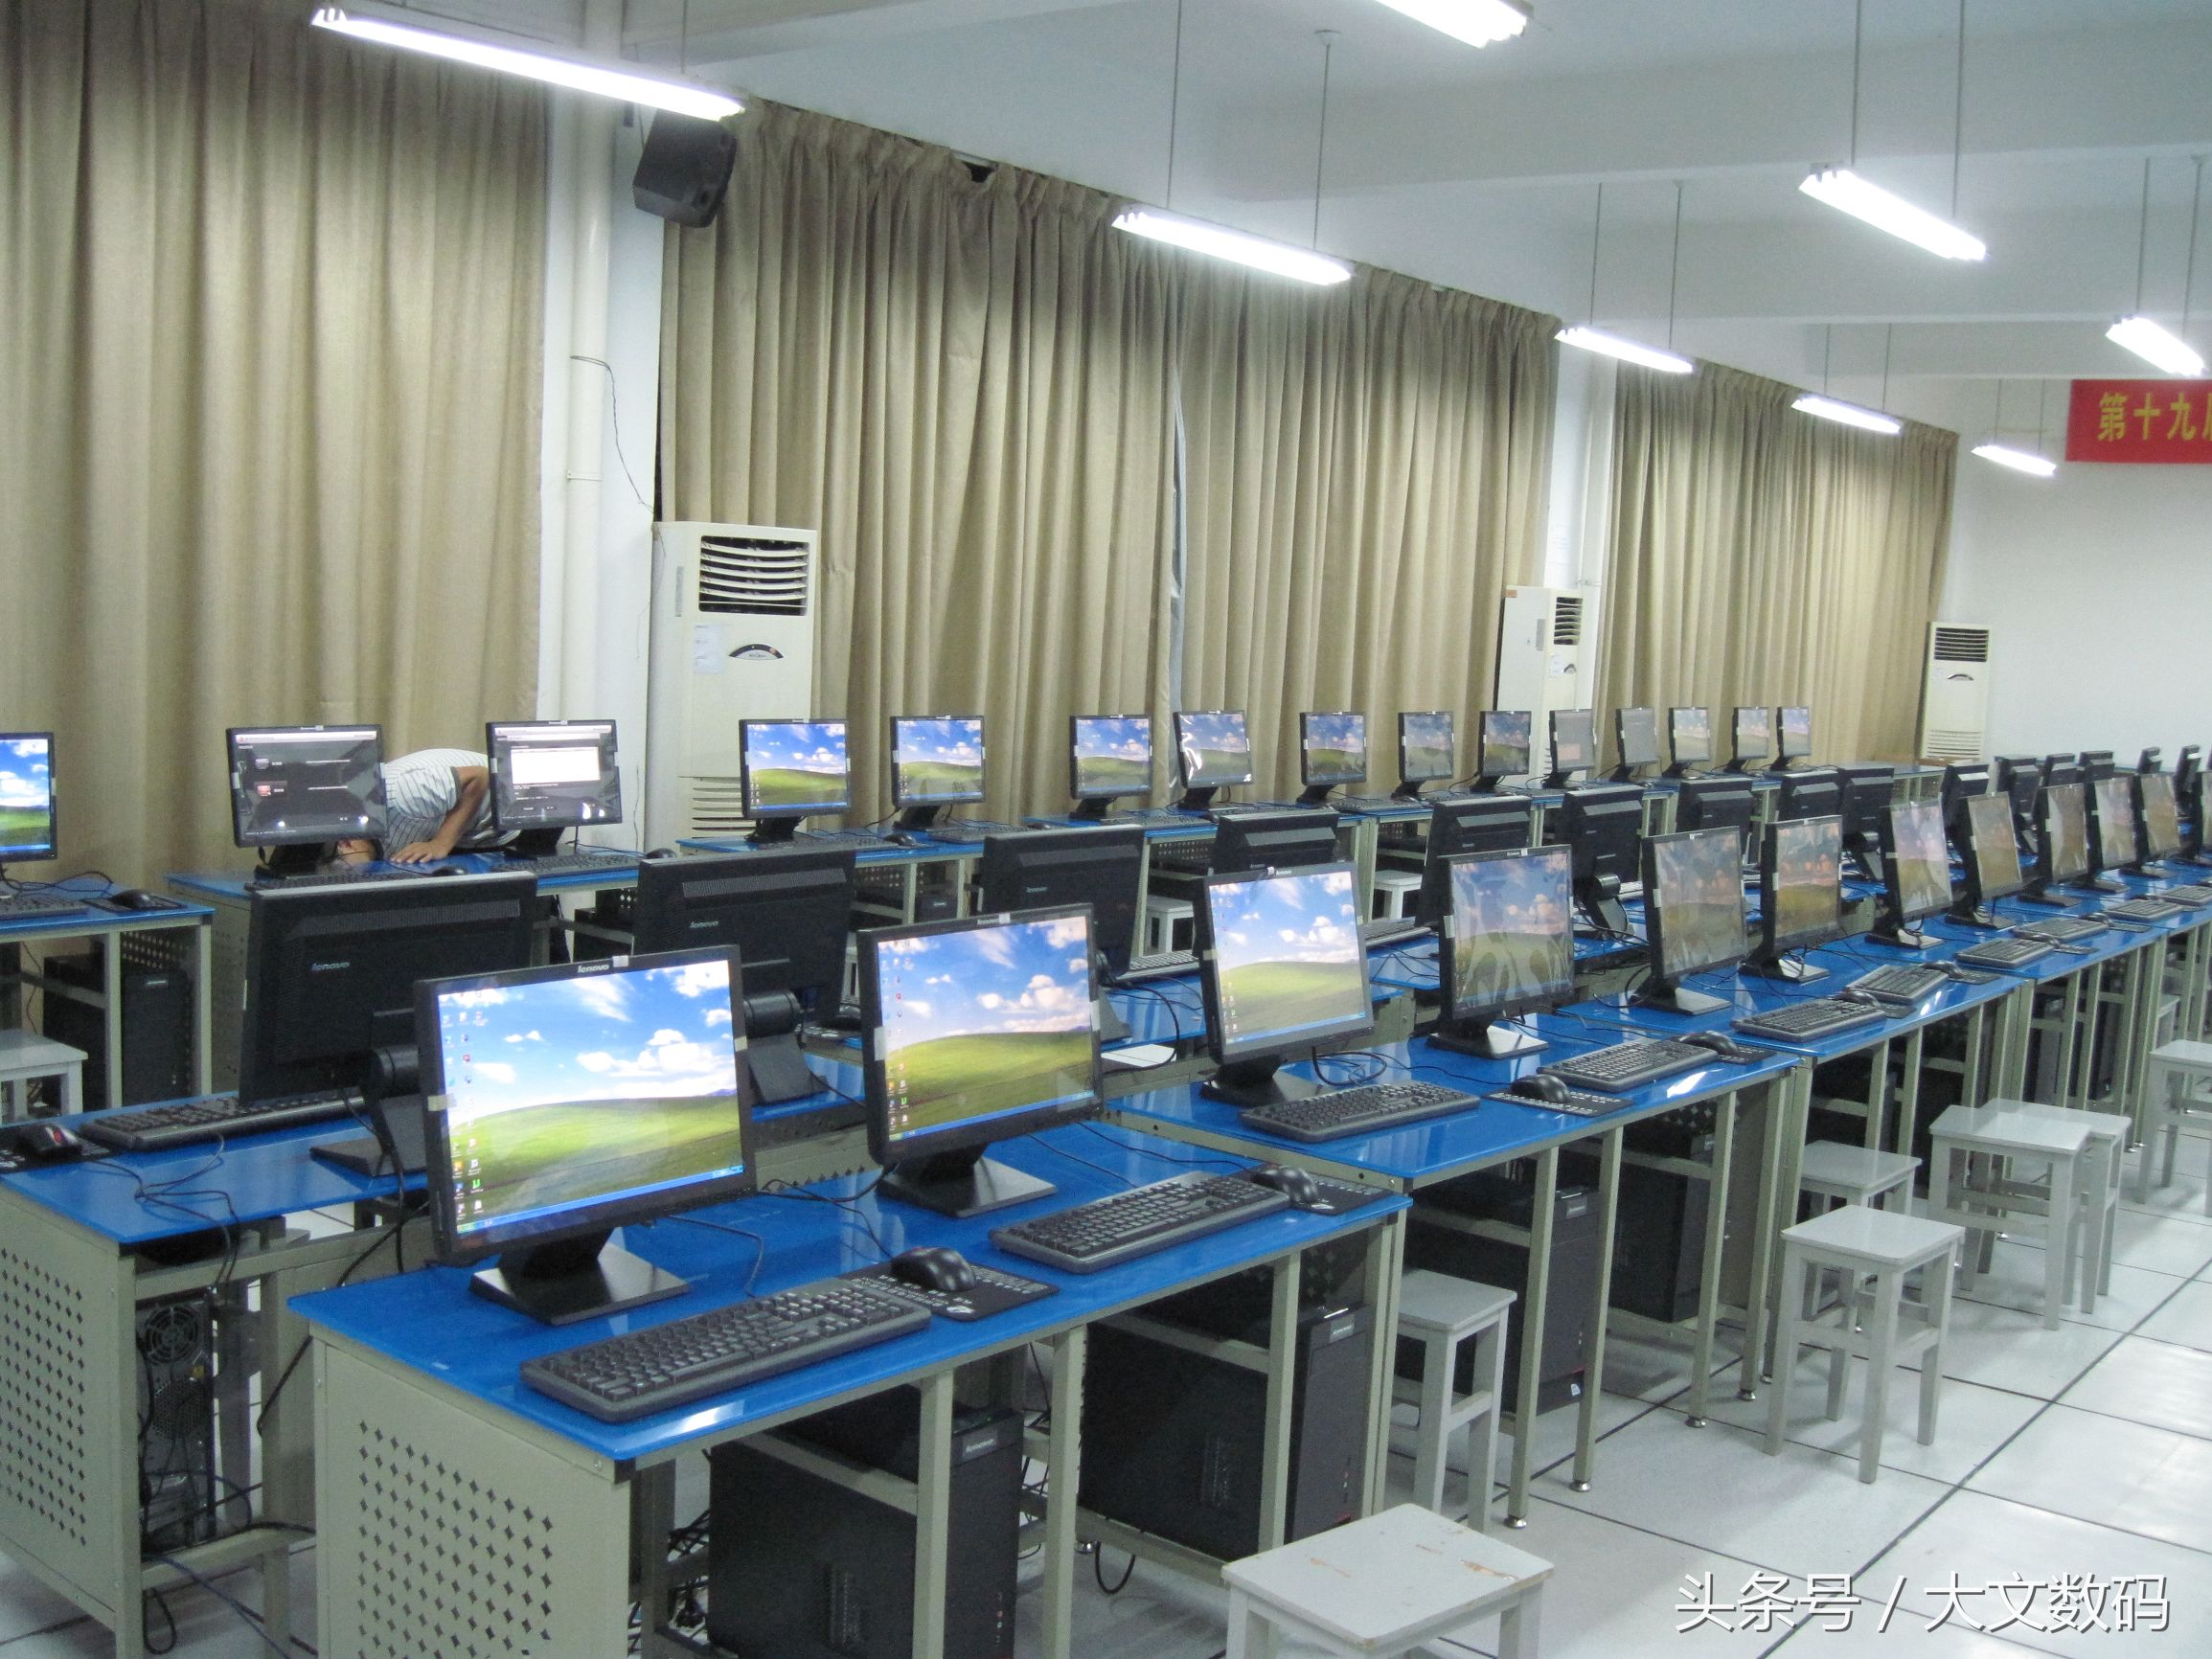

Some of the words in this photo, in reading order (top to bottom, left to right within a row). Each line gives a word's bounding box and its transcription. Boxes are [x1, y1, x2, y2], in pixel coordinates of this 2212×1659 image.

[2097, 391, 2212, 442] 第十九
[577, 964, 610, 974] lenovo
